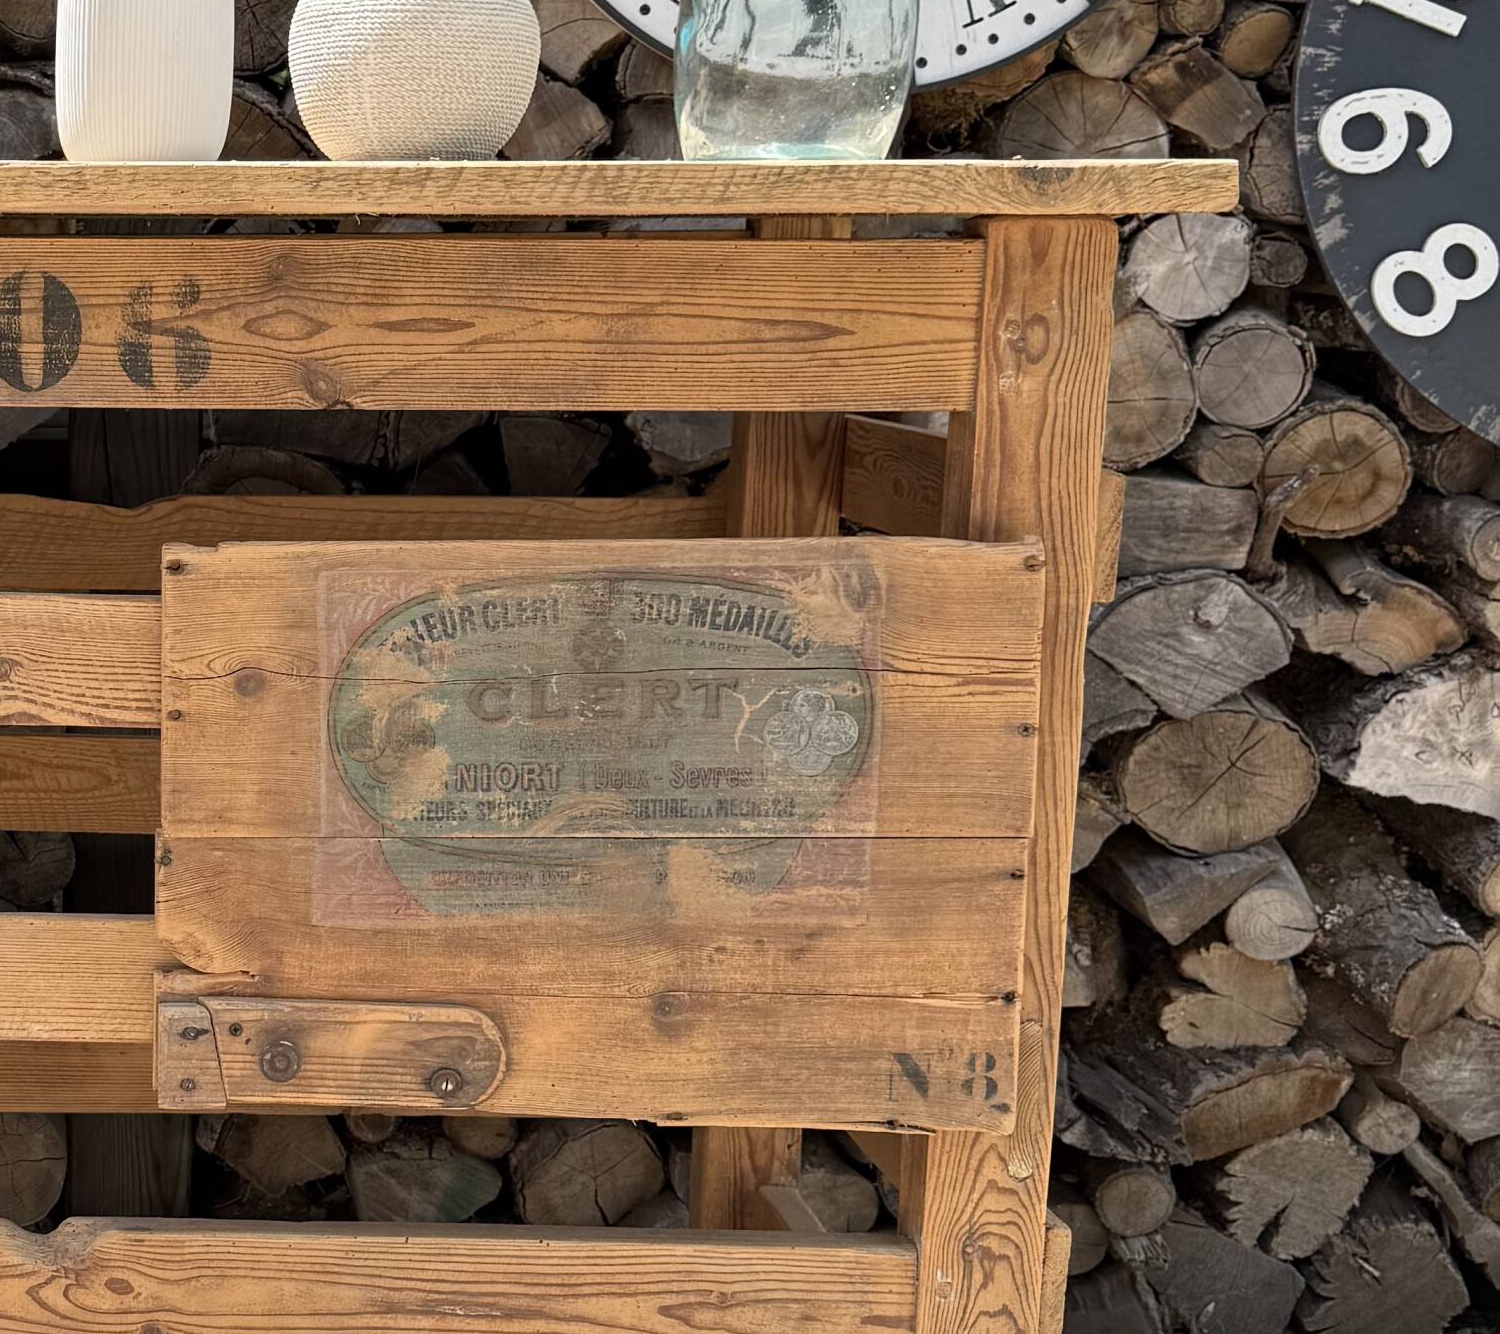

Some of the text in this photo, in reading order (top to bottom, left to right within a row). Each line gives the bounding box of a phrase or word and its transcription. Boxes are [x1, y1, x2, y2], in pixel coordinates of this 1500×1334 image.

[1317, 87, 1454, 177] 9
[1370, 222, 1500, 339] 8
[466, 677, 740, 723] CLERT
[455, 761, 564, 794] NIORT
